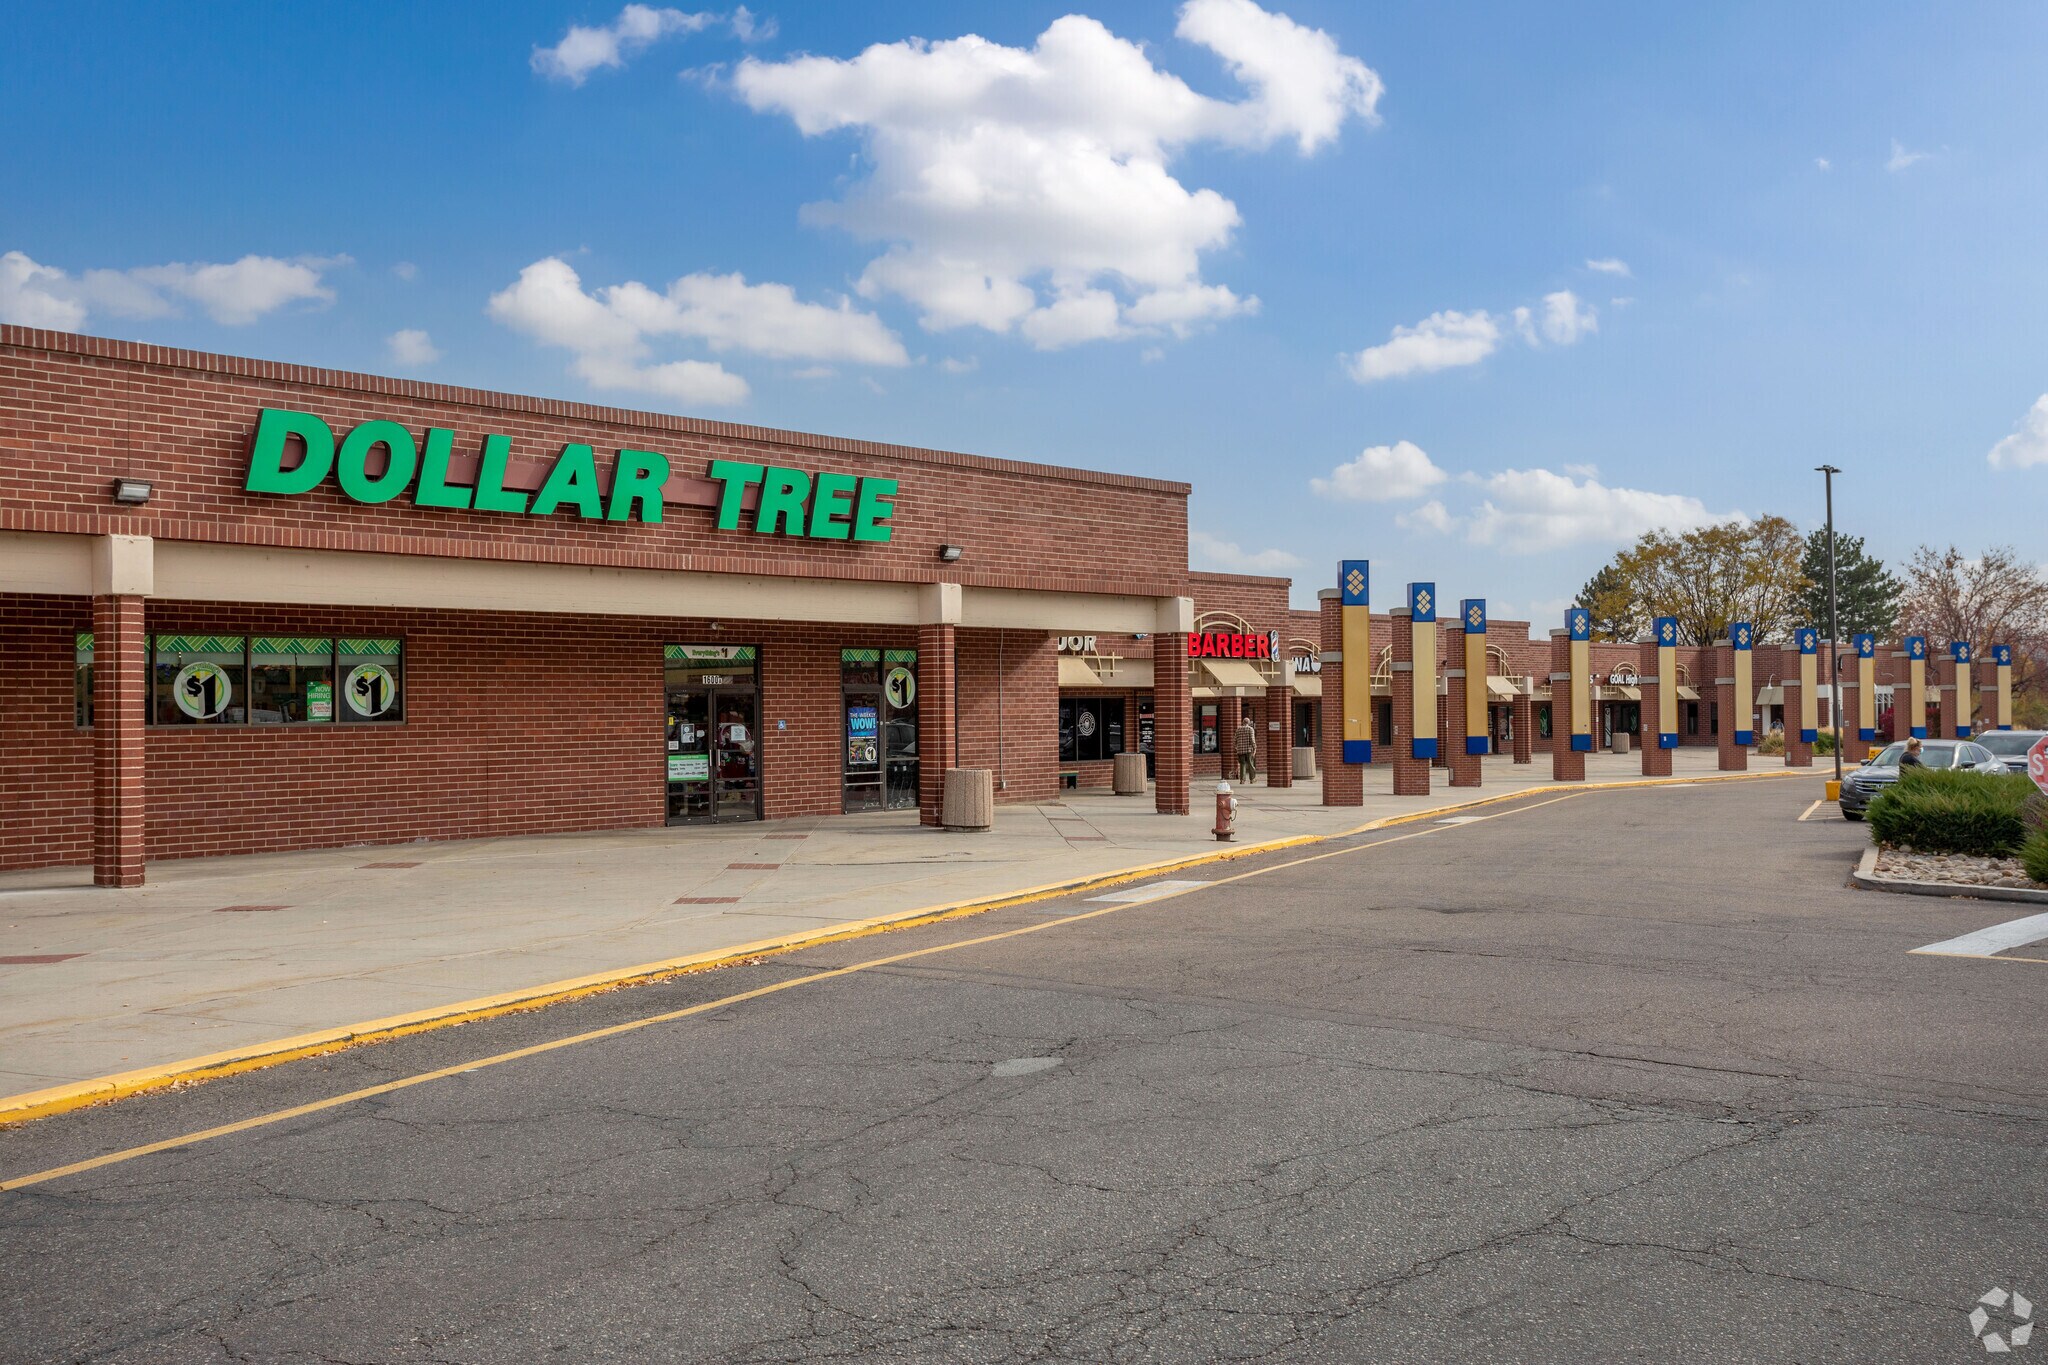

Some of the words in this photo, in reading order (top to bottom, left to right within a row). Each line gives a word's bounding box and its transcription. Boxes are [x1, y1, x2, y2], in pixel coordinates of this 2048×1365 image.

[243, 408, 671, 524] DOLLAR
[706, 459, 899, 542] TREE
[691, 649, 720, 658] Everything's
[721, 647, 728, 658] $1
[1187, 632, 1270, 659] BARBER
[1292, 656, 1311, 672] NA
[891, 675, 908, 707] $1
[1610, 674, 1625, 684] GOAL
[1625, 674, 1638, 687] High
[186, 673, 218, 717] $1
[355, 674, 383, 715] $1
[850, 717, 876, 730] WOW!
[867, 748, 874, 760] $1
[2032, 753, 2048, 776] S
